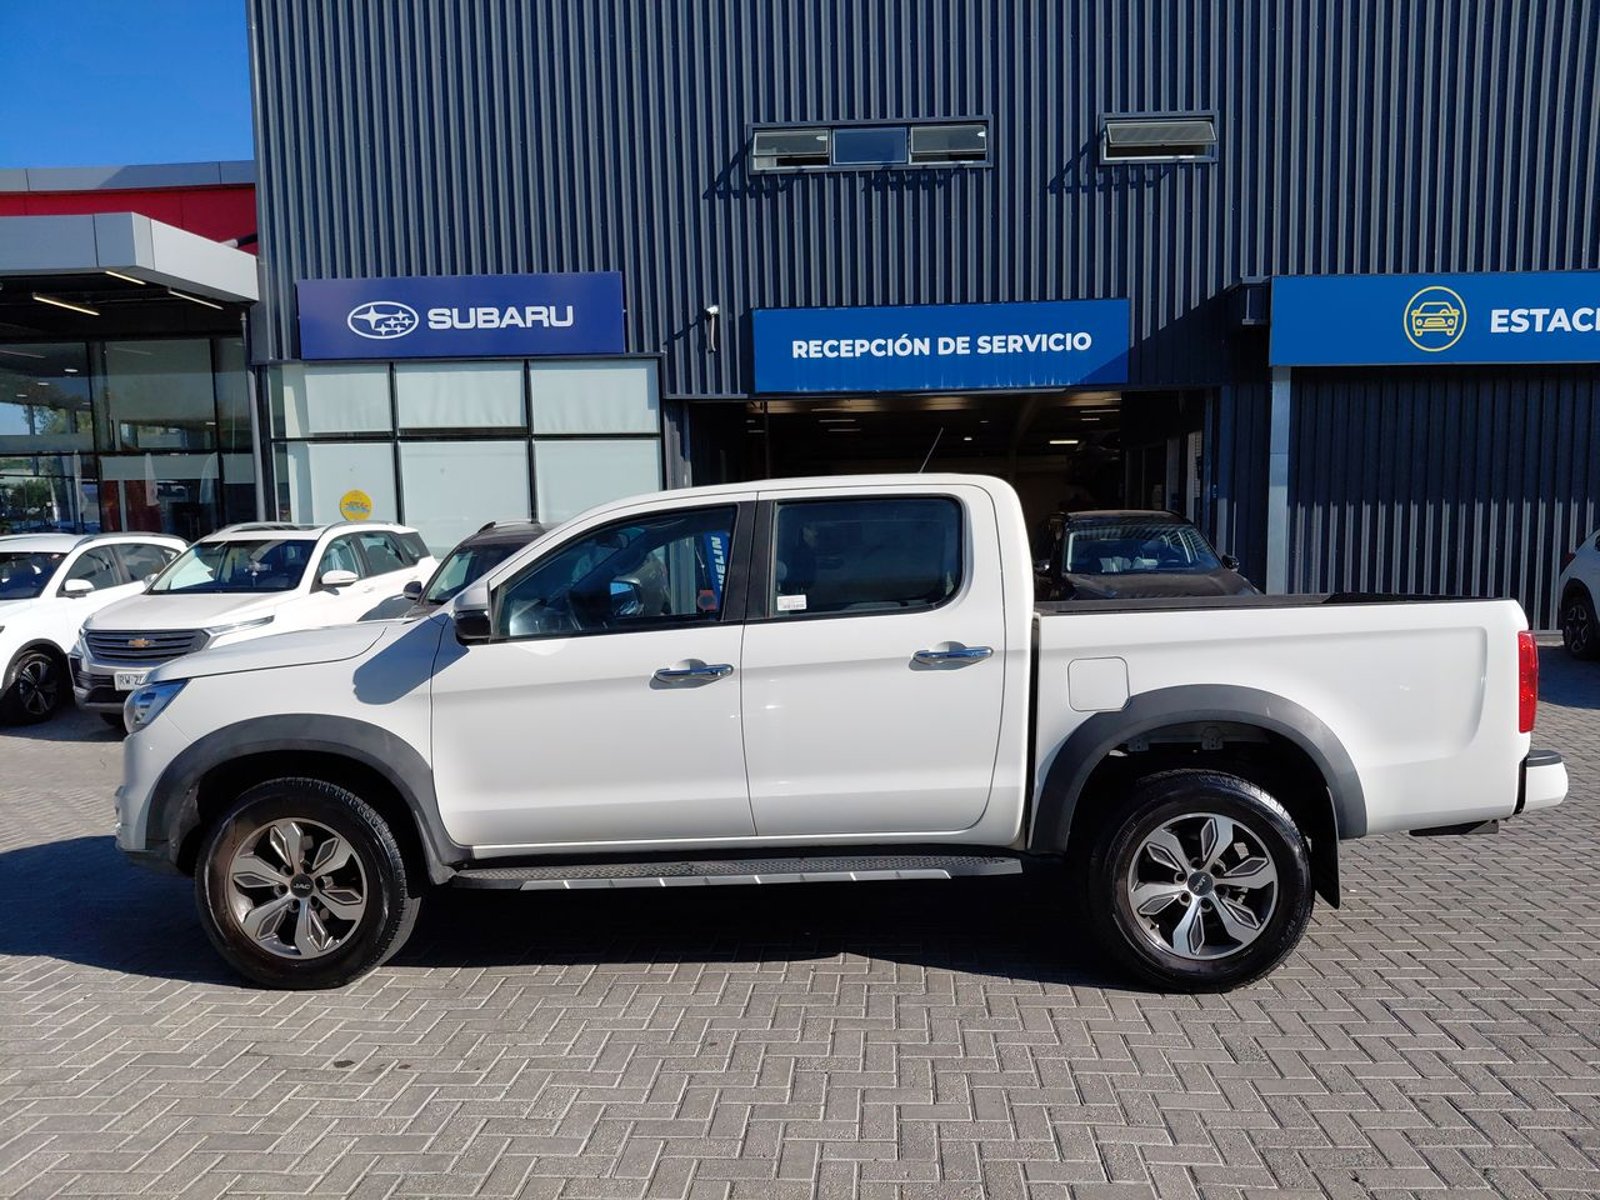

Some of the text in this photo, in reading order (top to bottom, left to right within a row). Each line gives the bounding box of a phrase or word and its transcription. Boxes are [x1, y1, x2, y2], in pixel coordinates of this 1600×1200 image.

[428, 305, 574, 329] SUBARU
[792, 332, 1092, 358] RECEPCIÓN DE SERVICIO
